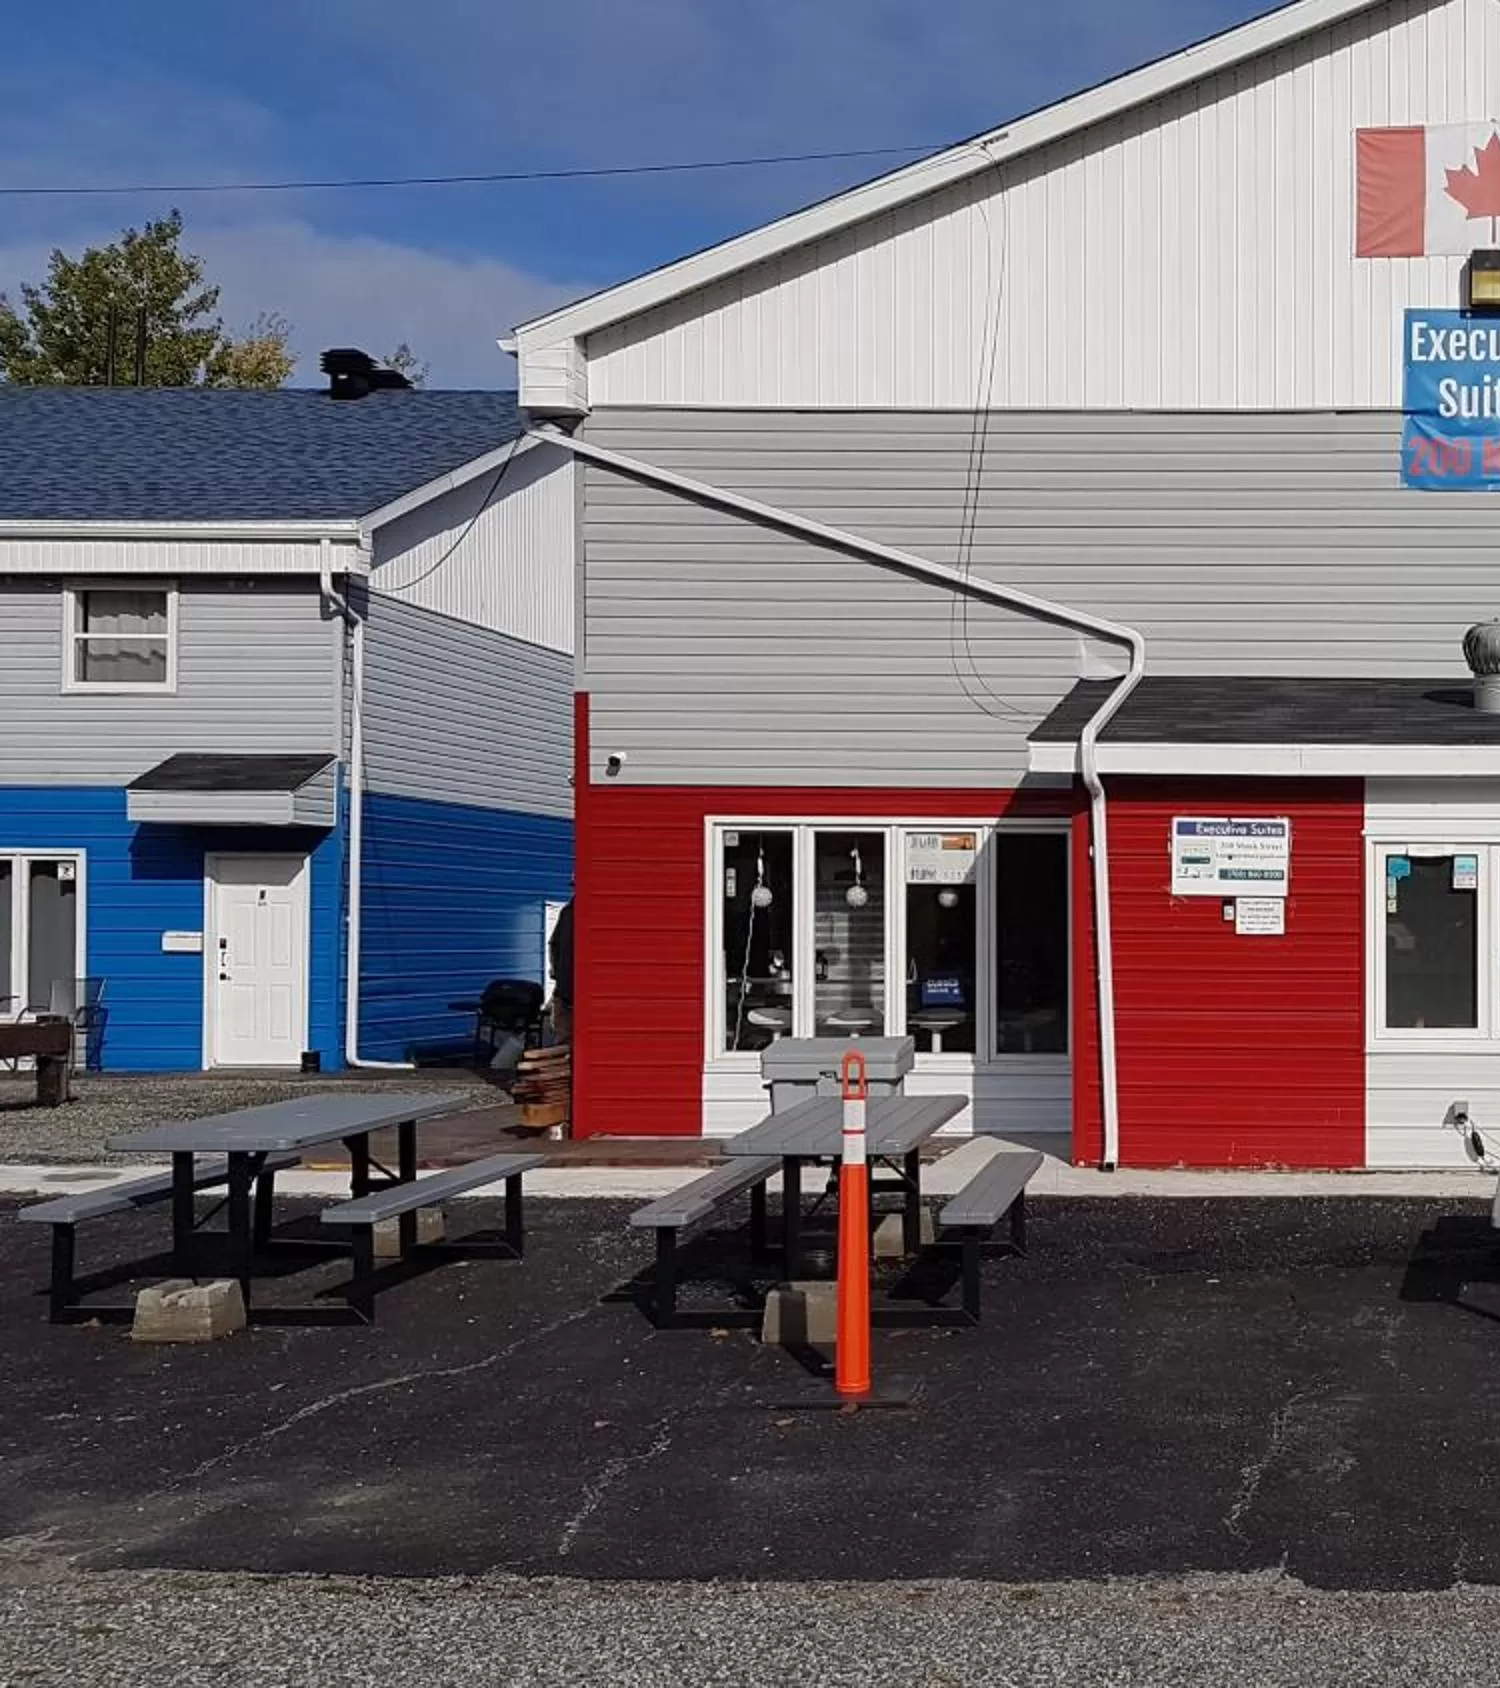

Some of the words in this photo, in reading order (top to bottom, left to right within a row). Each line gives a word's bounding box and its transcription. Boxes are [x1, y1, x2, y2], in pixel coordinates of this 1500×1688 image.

[1407, 435, 1472, 477] 200
[1196, 823, 1248, 835] Executive
[1251, 823, 1283, 835] Suites
